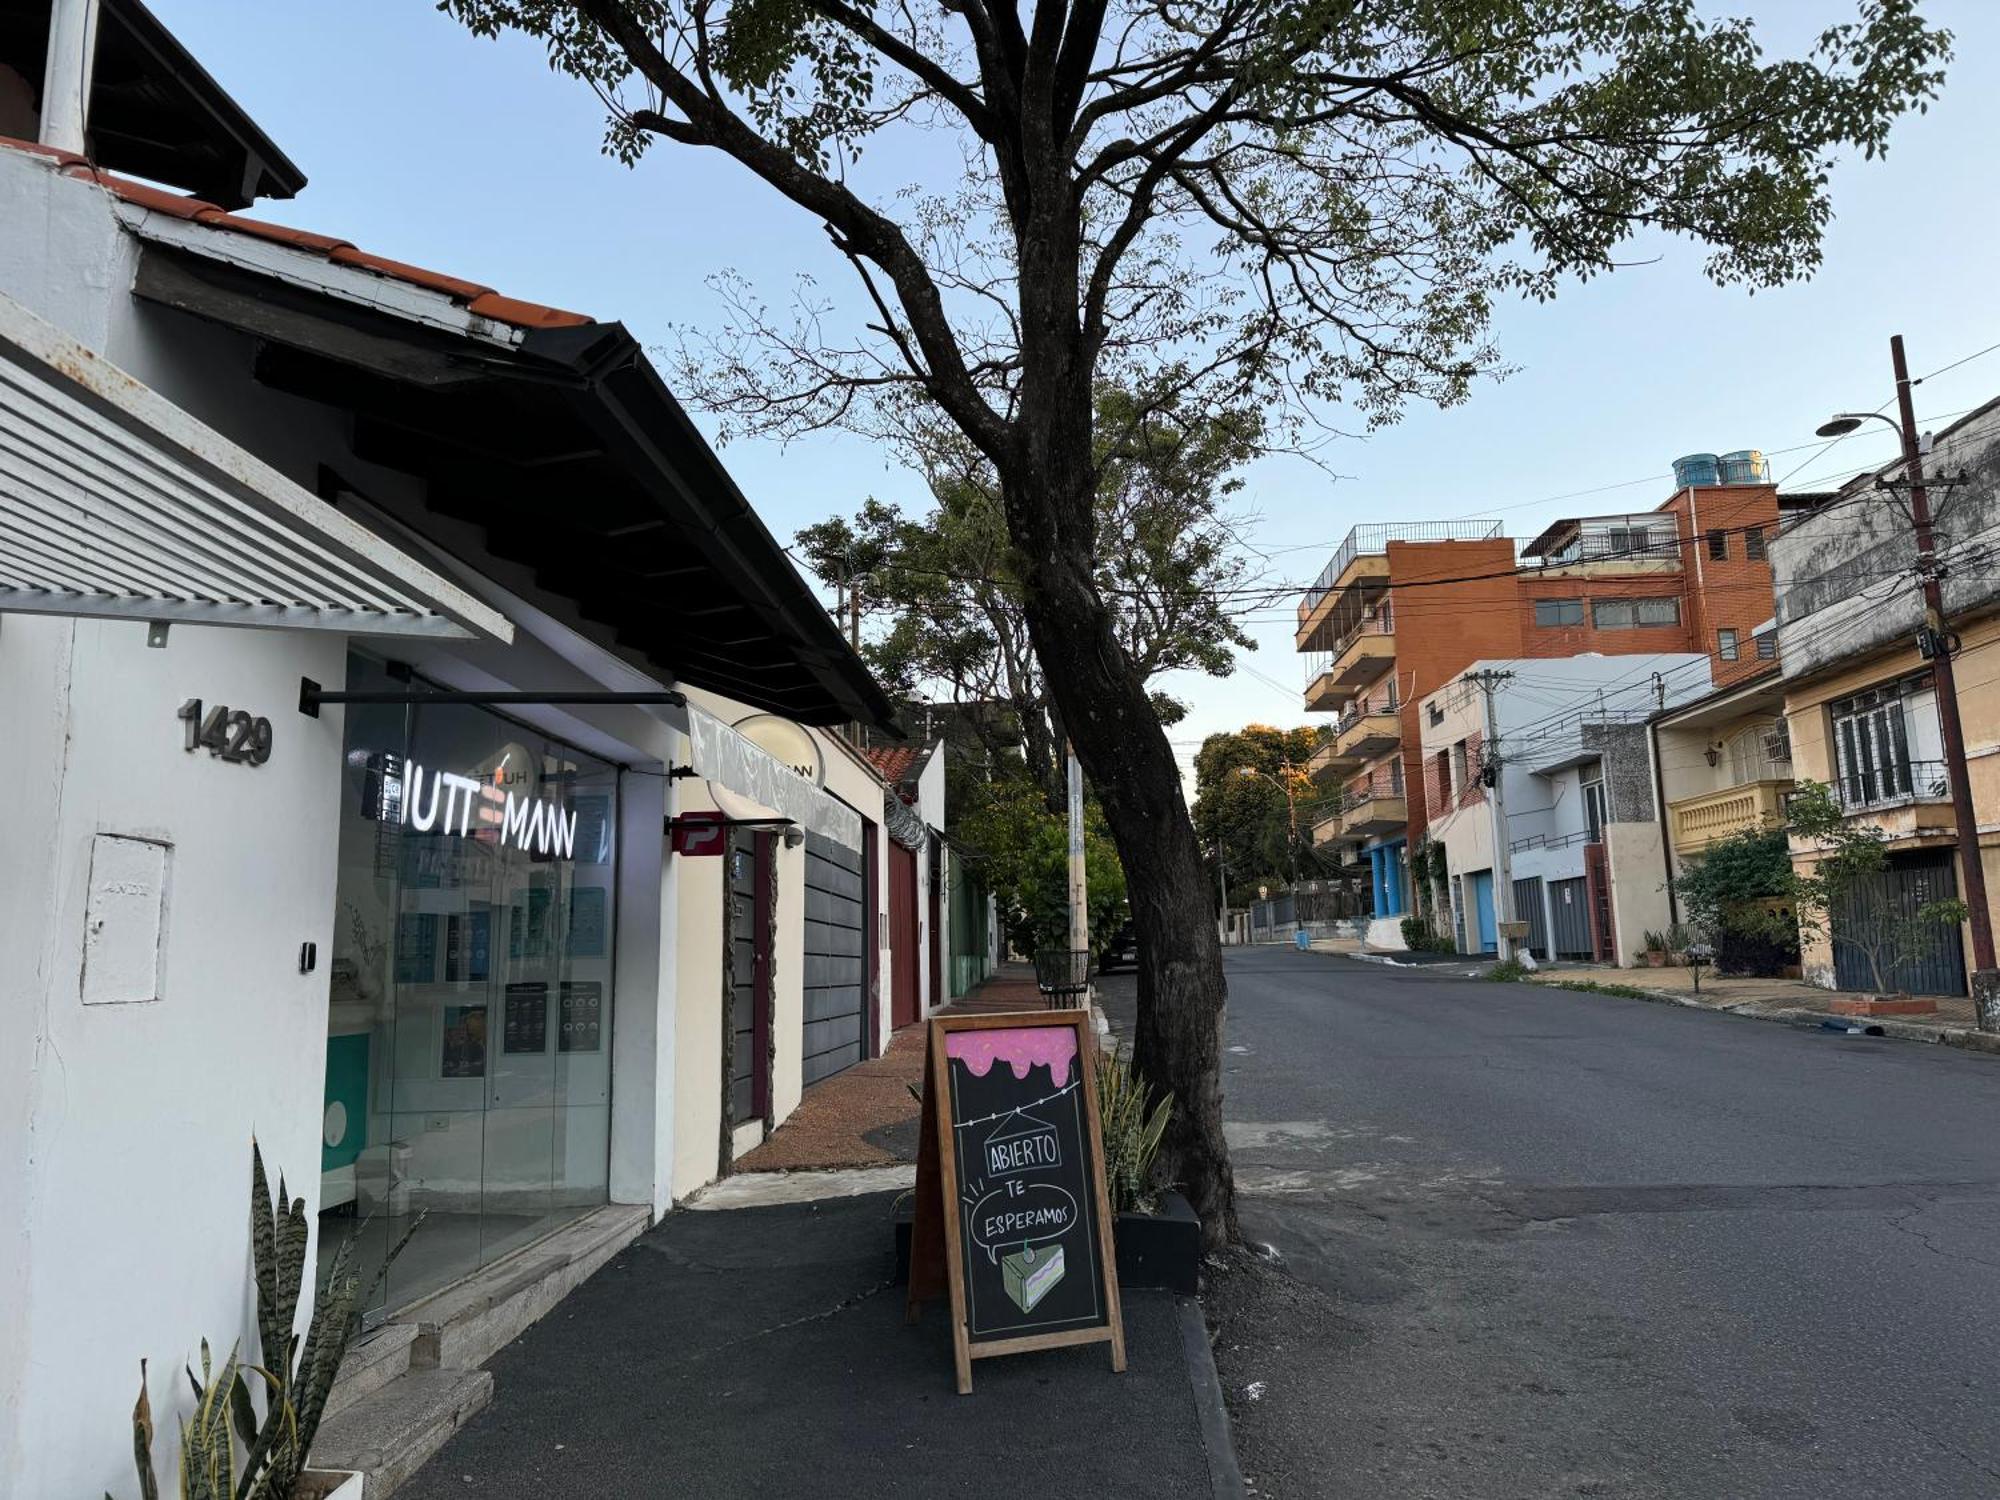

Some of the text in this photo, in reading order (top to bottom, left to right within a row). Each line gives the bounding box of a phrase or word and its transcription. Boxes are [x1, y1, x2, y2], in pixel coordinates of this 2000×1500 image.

[178, 698, 273, 768] 1429
[990, 1134, 1057, 1172] ABIERTO
[1005, 1180, 1025, 1198] TE
[985, 1206, 1068, 1238] ESPERAMOS
